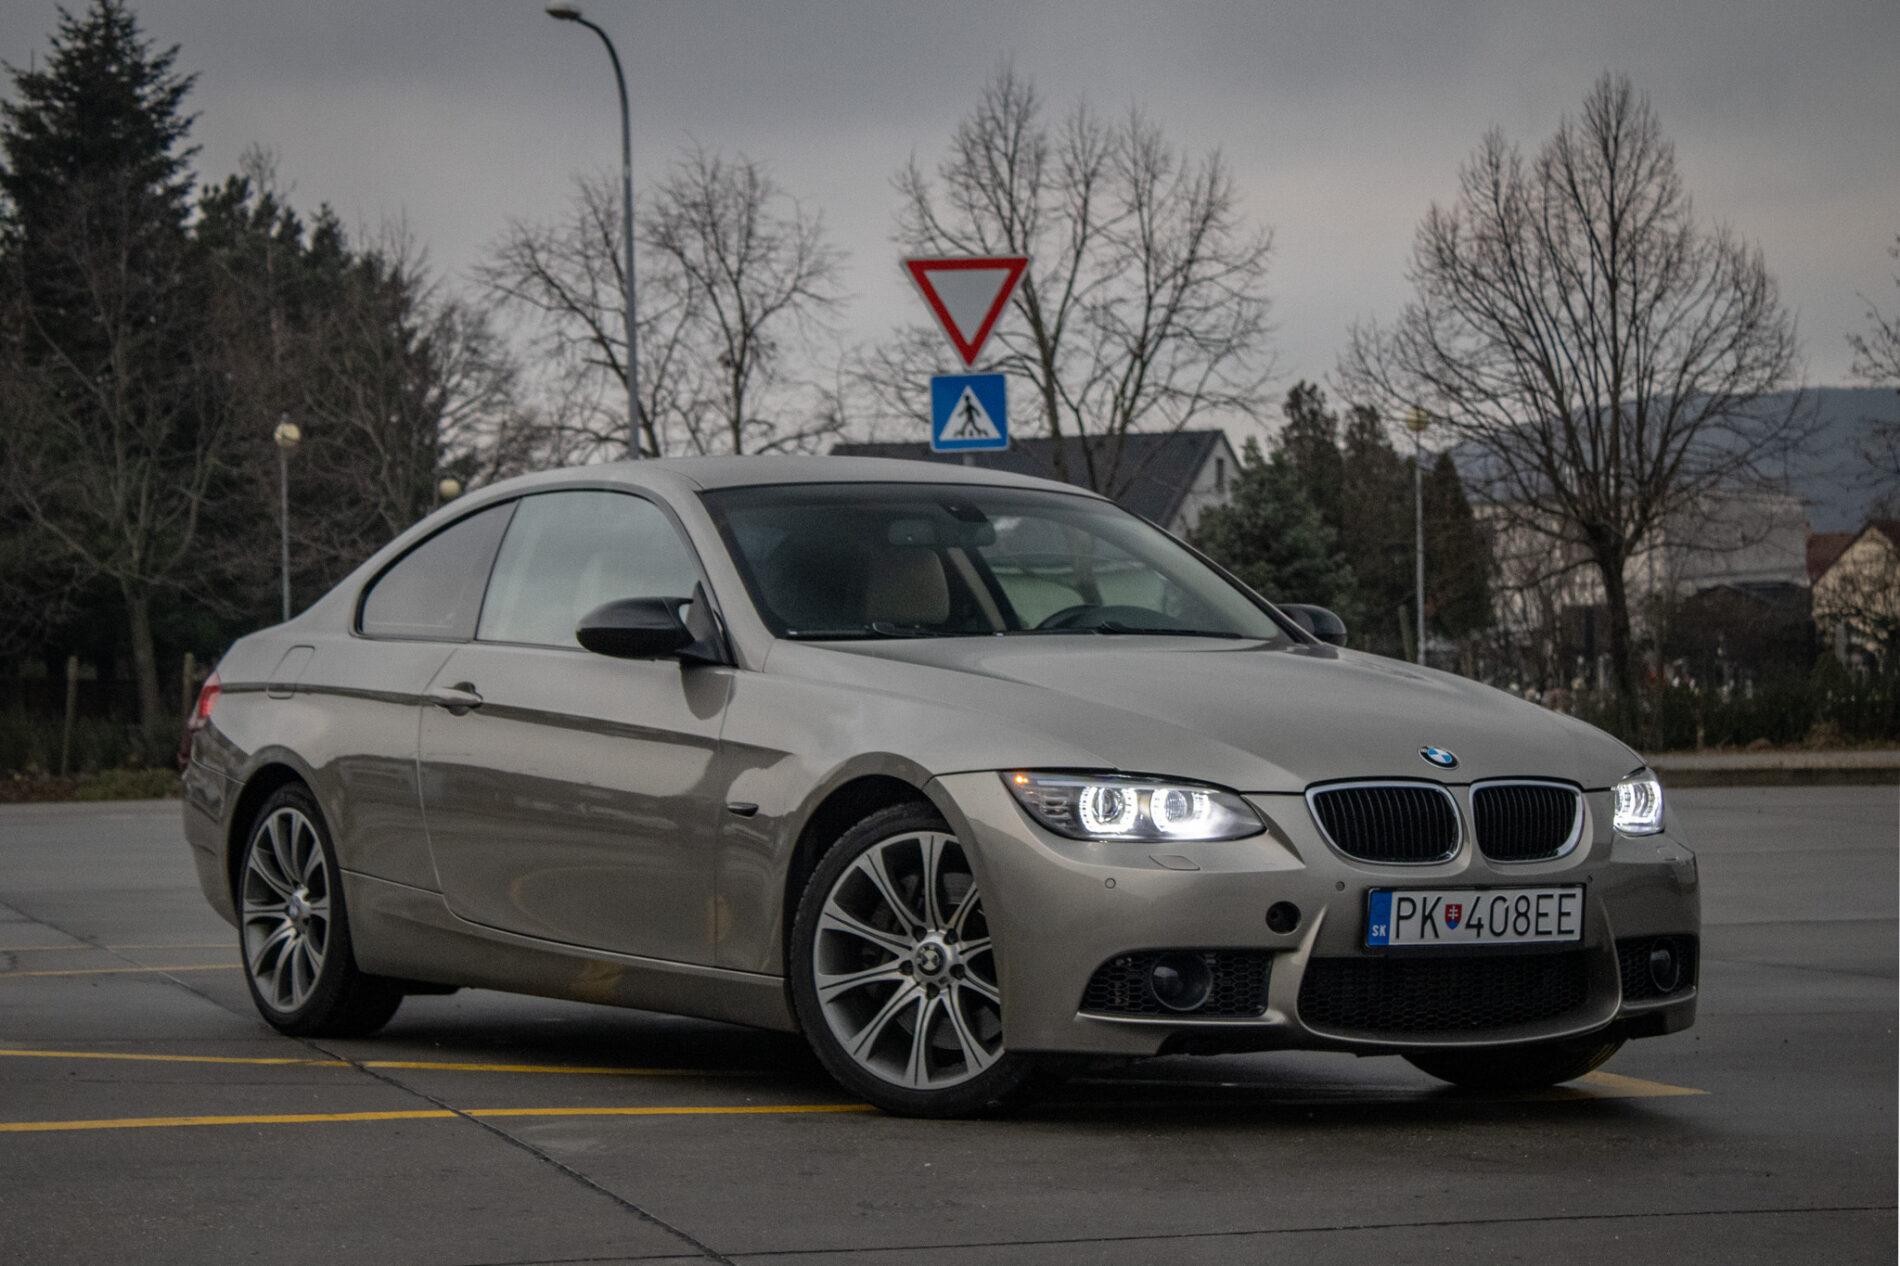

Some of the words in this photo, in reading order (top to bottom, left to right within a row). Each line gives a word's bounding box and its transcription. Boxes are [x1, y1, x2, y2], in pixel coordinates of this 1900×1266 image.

[1371, 924, 1387, 937] SK
[1395, 896, 1443, 939] PK
[1465, 893, 1577, 938] 408EE
